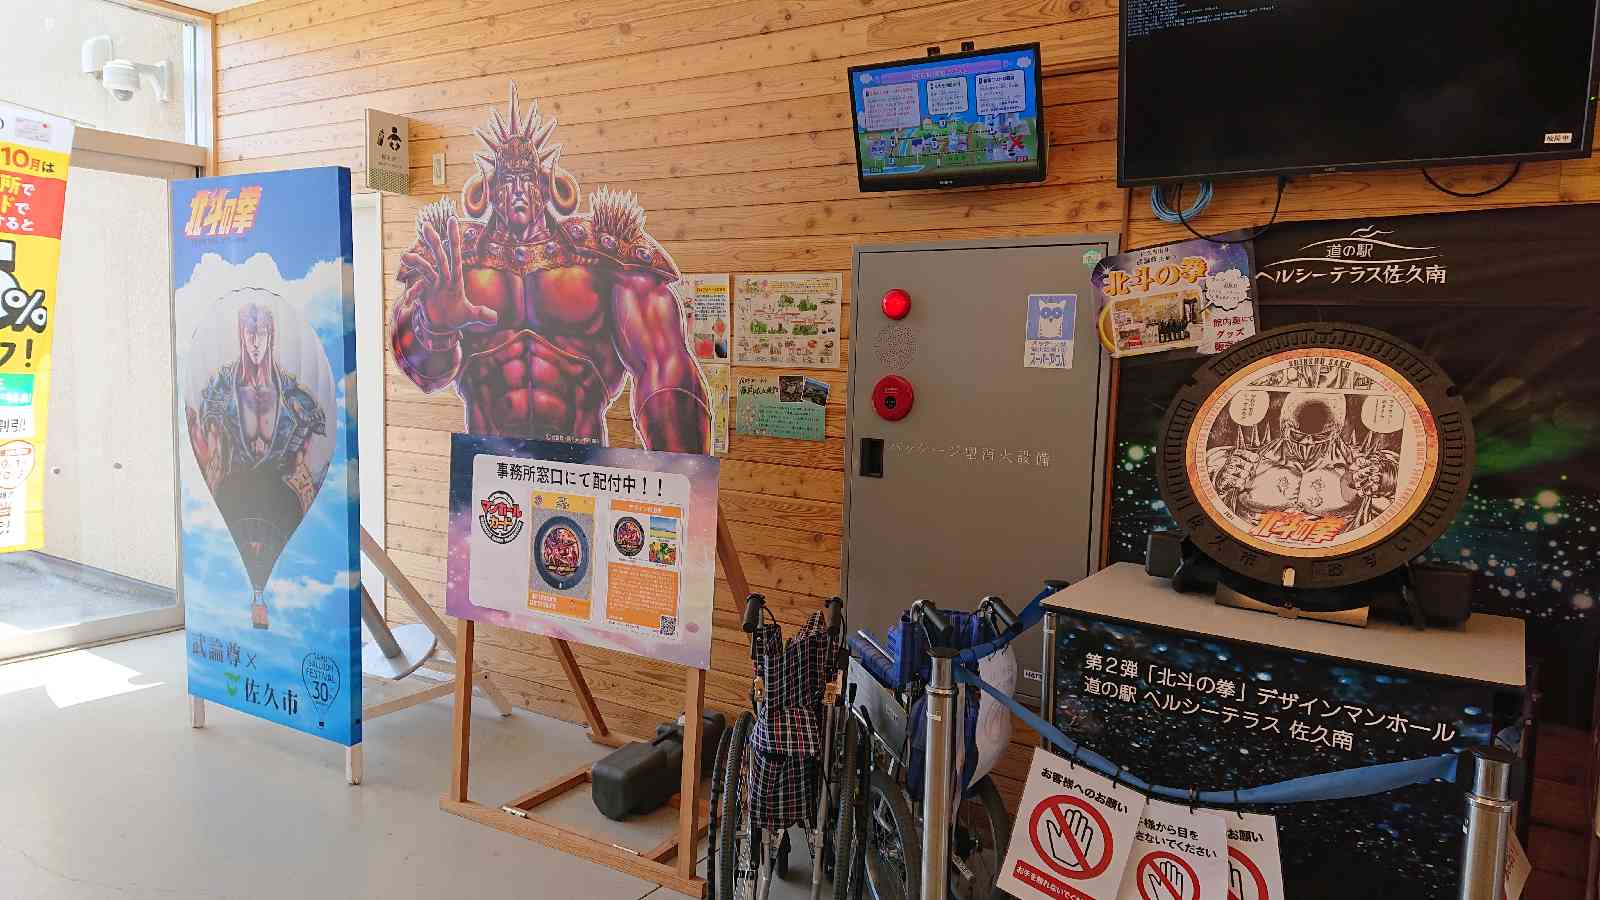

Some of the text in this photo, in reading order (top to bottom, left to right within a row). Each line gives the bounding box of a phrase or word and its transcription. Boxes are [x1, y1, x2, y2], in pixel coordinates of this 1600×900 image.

[0, 216, 34, 232] ると
[185, 186, 263, 237] 北斗の拳
[1326, 243, 1374, 259] 道の駅
[1103, 256, 1209, 297] 北斗の拳
[1255, 264, 1448, 285] ヘルシーテラス佐久南
[496, 461, 664, 497] 事務所窓口にて配付中！！
[481, 499, 523, 518] マンホール
[489, 514, 513, 531] カード
[245, 677, 298, 715] 佐久市
[1084, 676, 1353, 752] 道の駅 ヘルシーテラス 佐久南
[1040, 767, 1128, 814] お客様へのお願い
[1136, 830, 1218, 859] さないでください
[1016, 865, 1090, 900] お手を触れないでく
